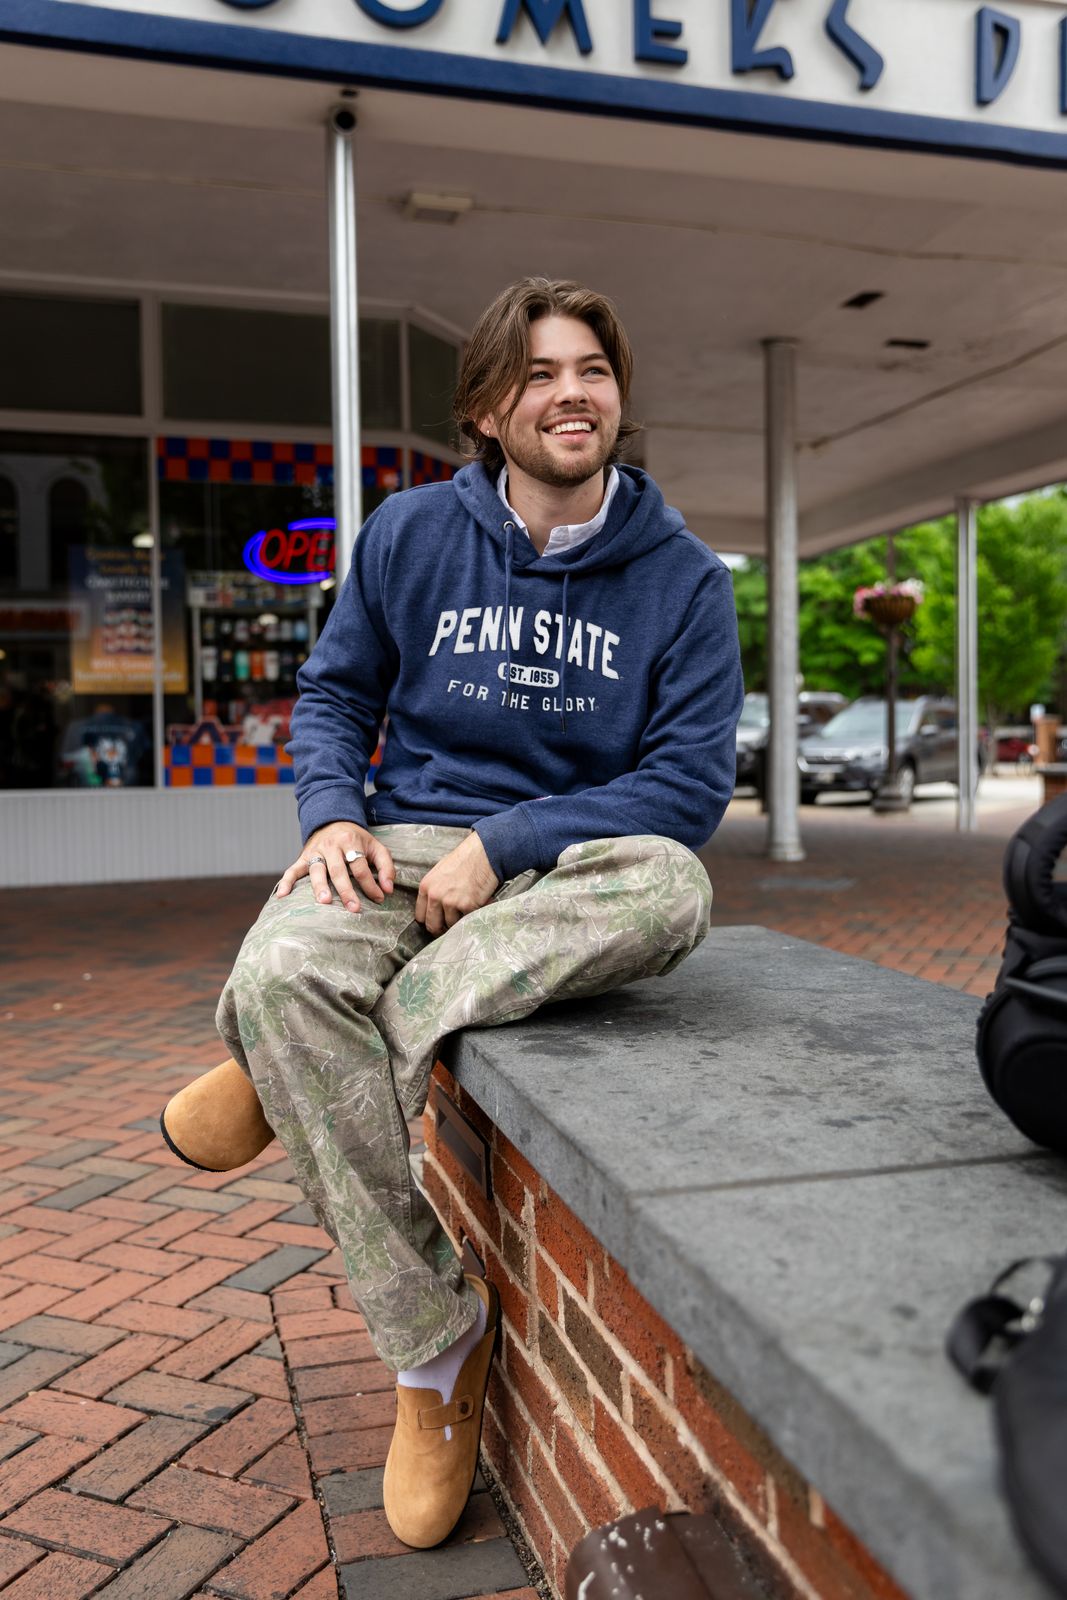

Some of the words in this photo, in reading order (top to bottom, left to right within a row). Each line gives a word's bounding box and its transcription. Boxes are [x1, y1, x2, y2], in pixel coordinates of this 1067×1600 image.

[976, 6, 1067, 115] D
[428, 605, 524, 657] PENN
[533, 609, 620, 680] STATE
[447, 680, 489, 701] FOR
[501, 690, 530, 710] THE
[542, 697, 596, 712] GLORY
[530, 670, 554, 685] 1855
